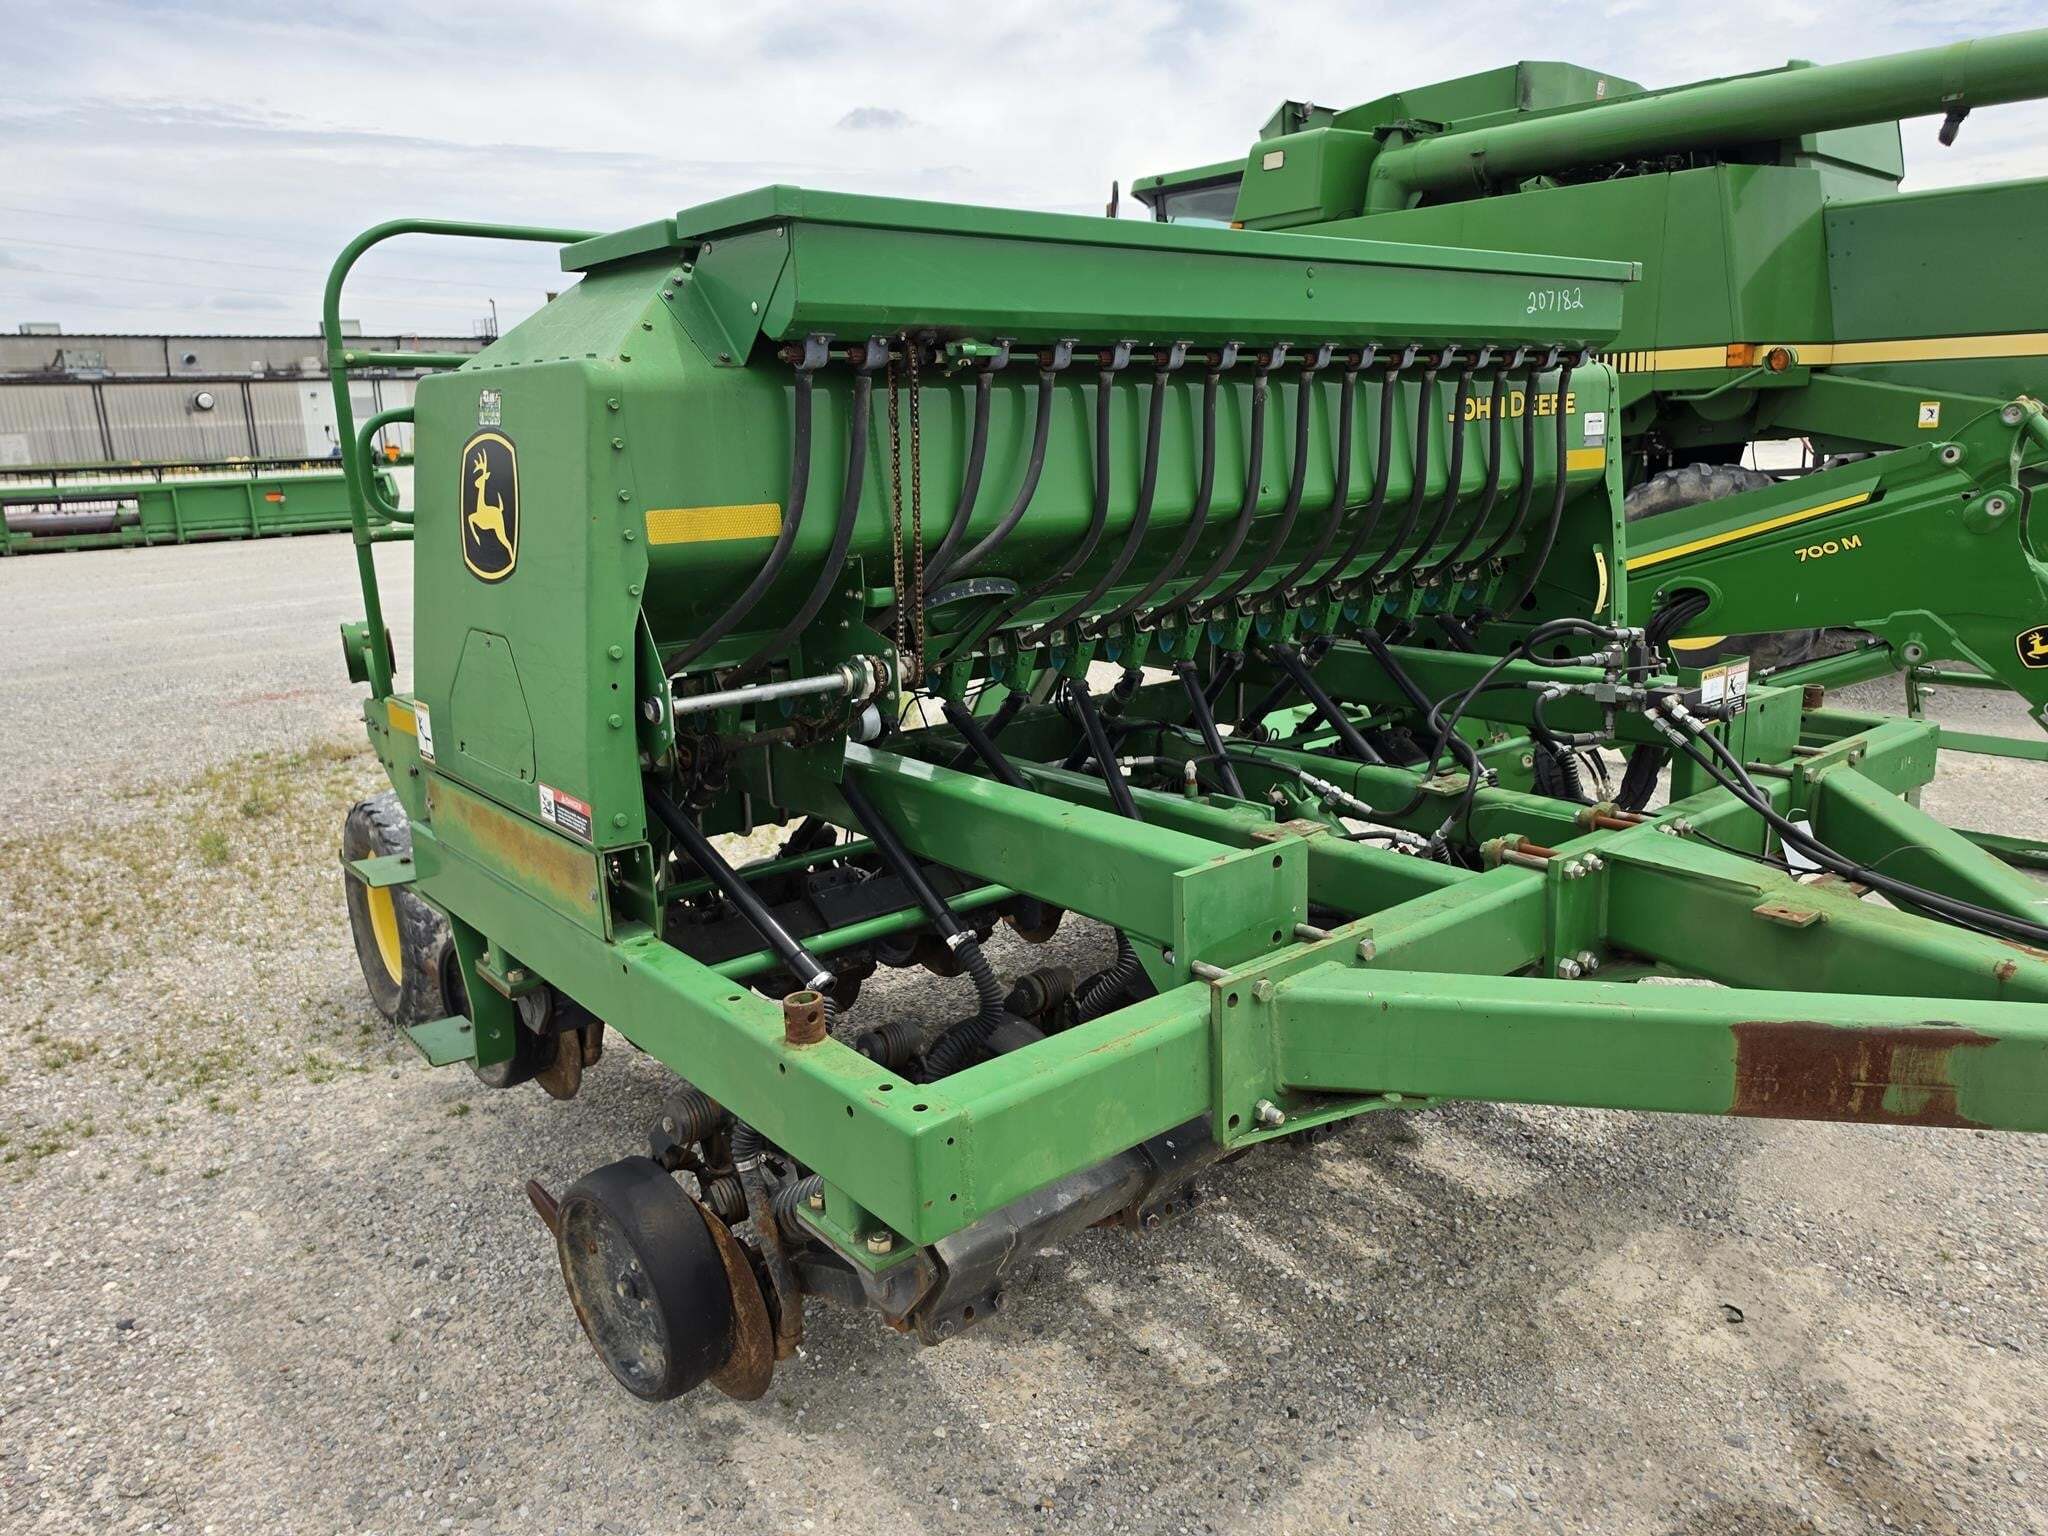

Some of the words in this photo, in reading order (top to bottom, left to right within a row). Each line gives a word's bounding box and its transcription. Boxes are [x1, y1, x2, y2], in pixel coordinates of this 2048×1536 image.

[1527, 287, 1584, 314] 207182
[1448, 396, 1505, 422] OH
[1794, 541, 1839, 563] 700
[1842, 534, 1862, 551] M
